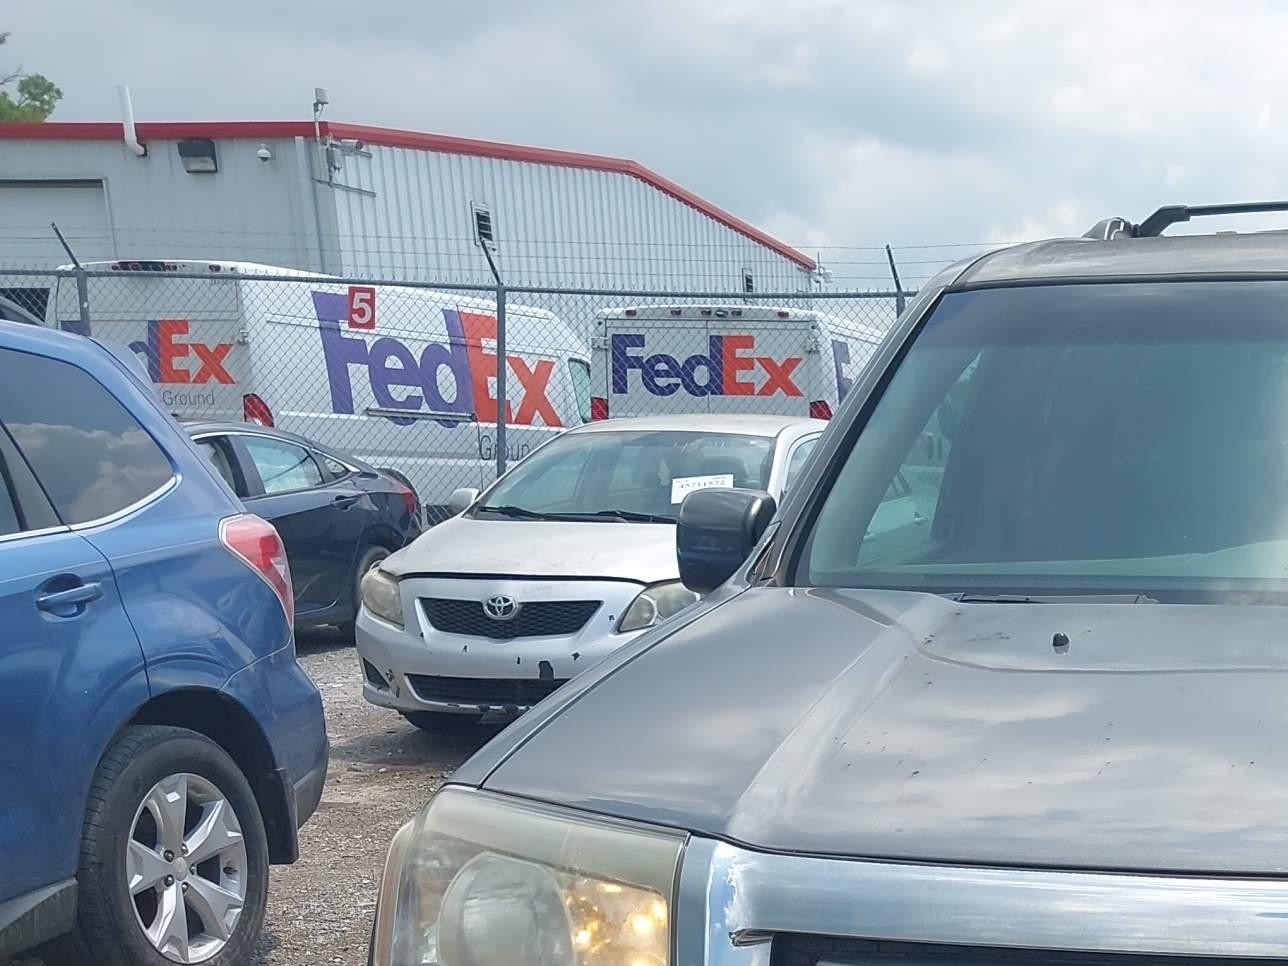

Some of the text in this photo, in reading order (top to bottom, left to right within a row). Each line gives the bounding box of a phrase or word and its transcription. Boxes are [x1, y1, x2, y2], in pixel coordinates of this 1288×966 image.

[351, 292, 372, 324] 5
[311, 290, 562, 428] FedEx
[611, 333, 805, 397] FedEx
[163, 390, 215, 406] Ground
